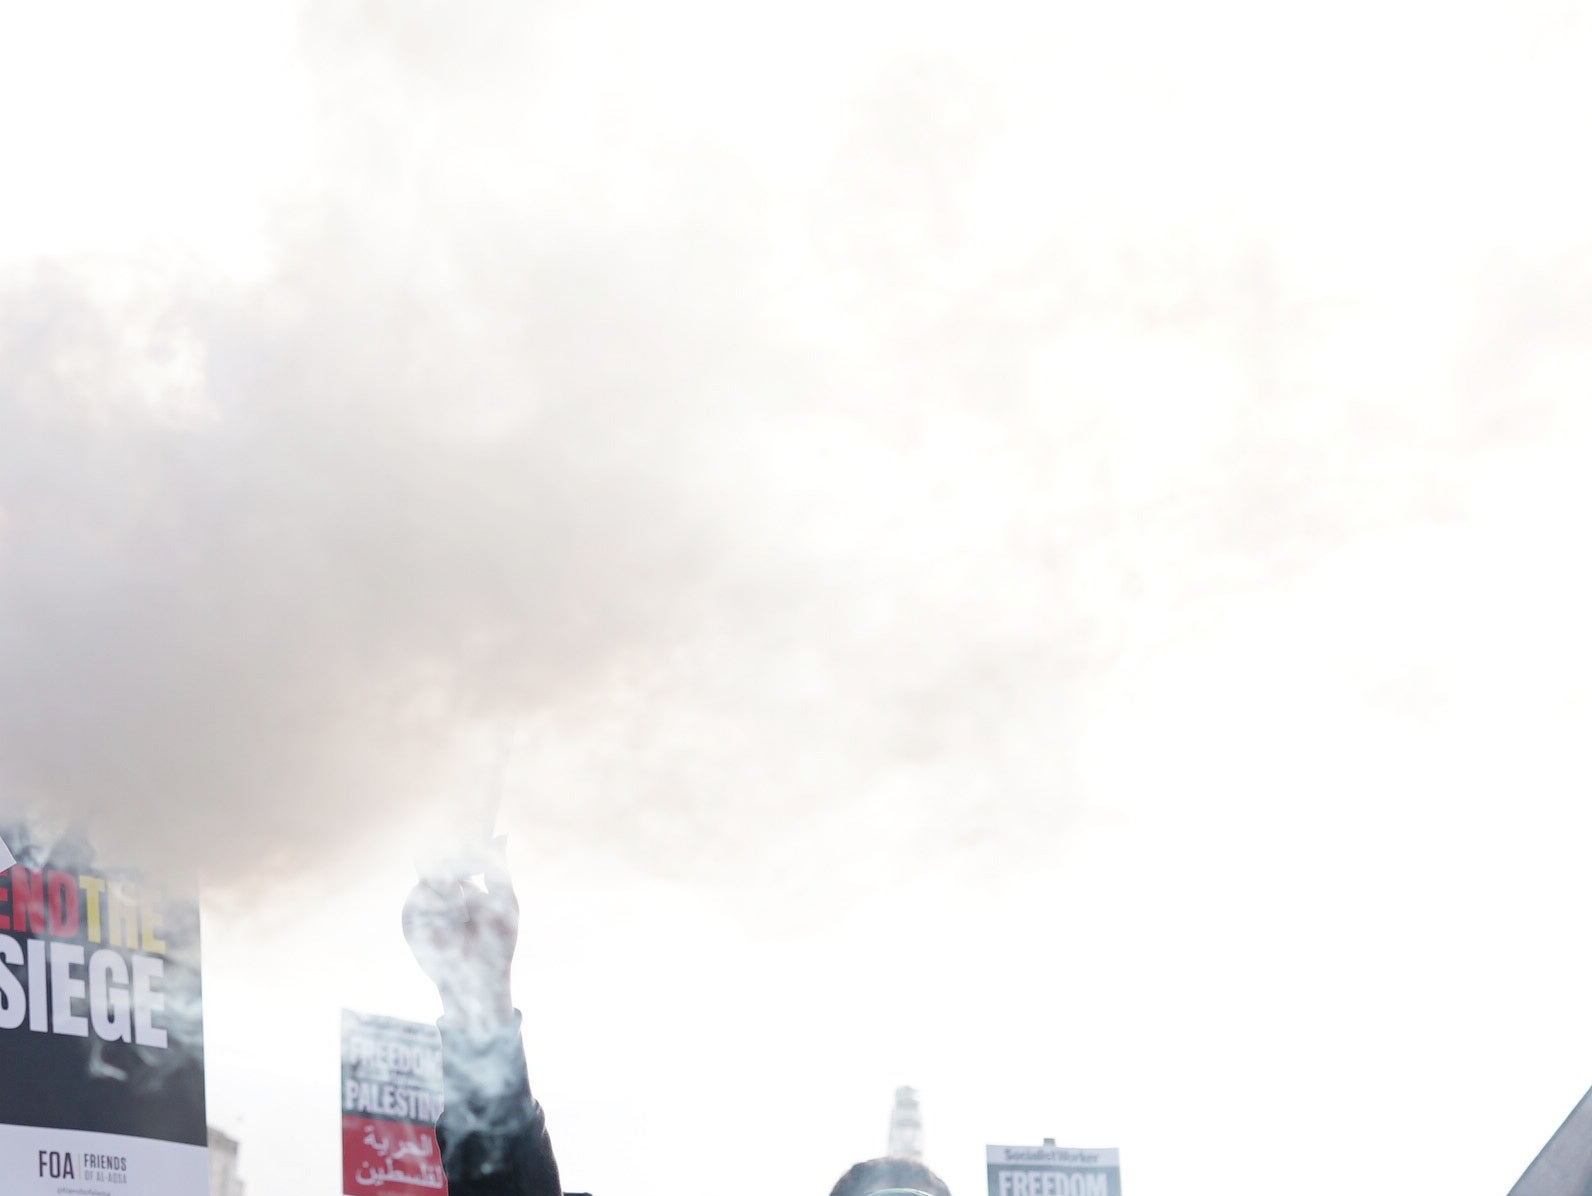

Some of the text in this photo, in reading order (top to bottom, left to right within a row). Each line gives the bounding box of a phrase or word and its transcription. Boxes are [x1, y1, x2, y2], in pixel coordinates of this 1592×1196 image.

[79, 875, 166, 955] THE
[344, 1079, 444, 1122] PALESTIN
[39, 1149, 75, 1179] FOA
[84, 1153, 127, 1171] FRIENDS
